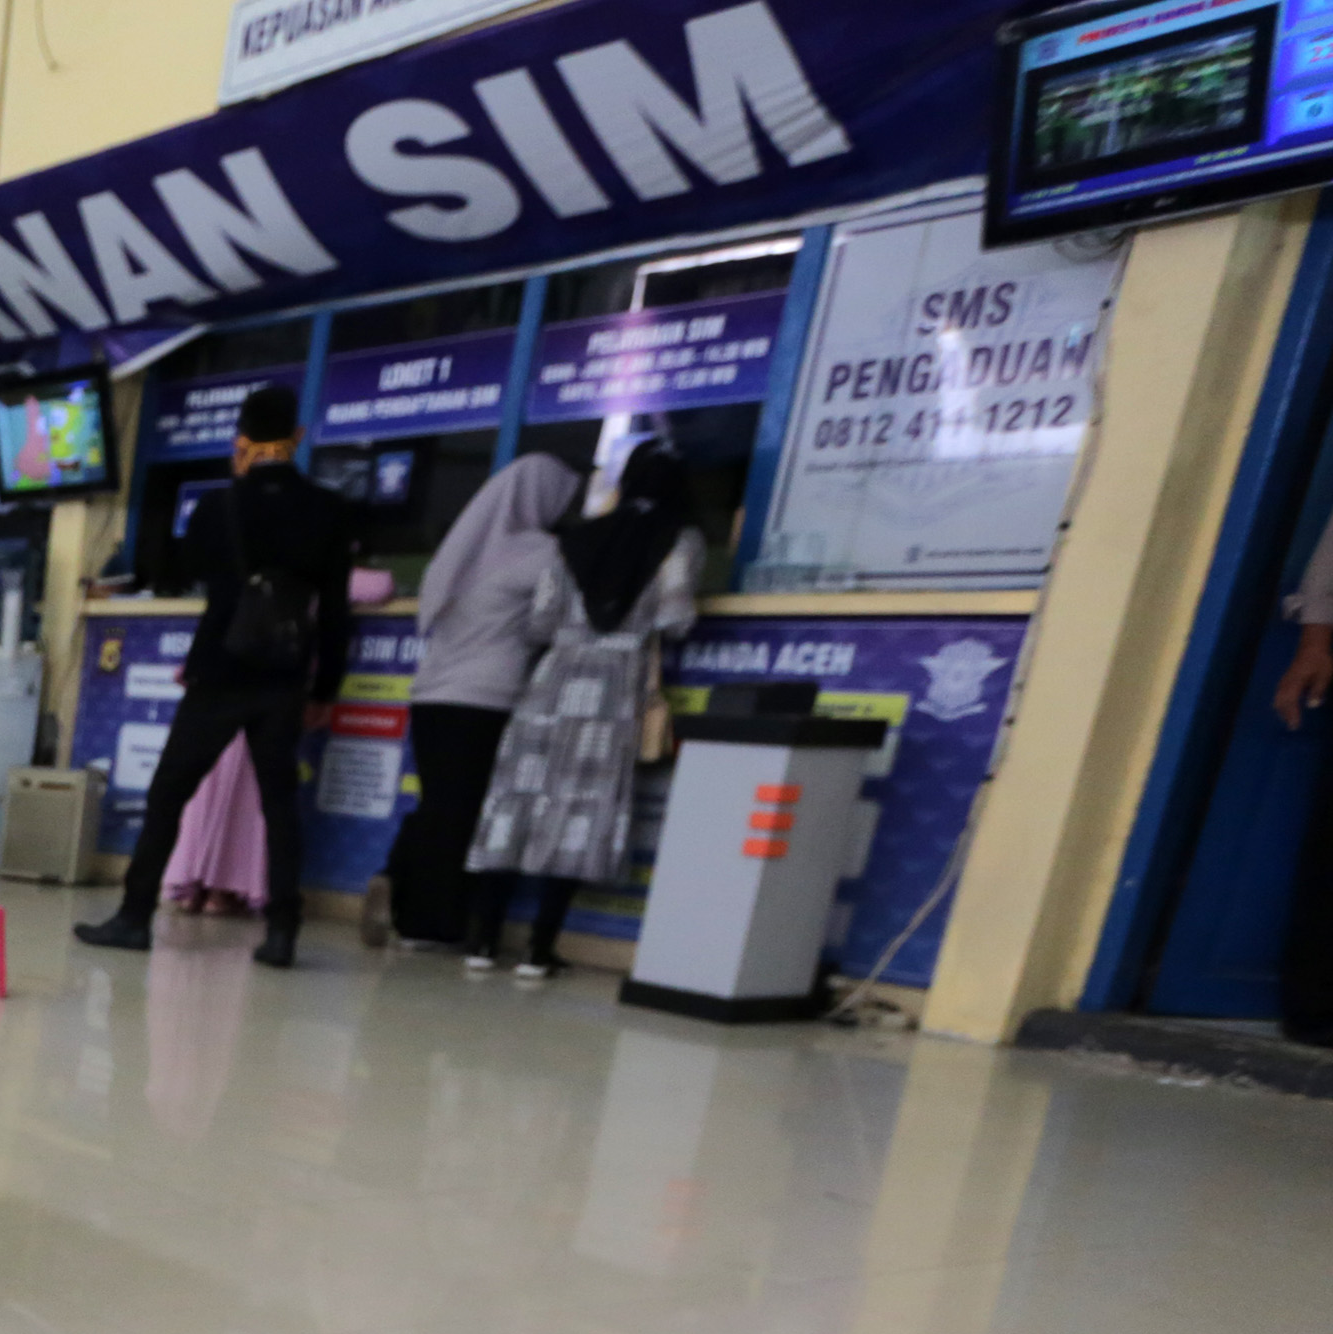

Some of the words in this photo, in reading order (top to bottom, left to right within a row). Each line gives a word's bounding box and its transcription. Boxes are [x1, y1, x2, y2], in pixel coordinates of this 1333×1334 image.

[344, 0, 853, 242] SIM
[917, 282, 1017, 335] SMS
[824, 332, 1094, 404] PENGADUAN
[814, 412, 896, 449] 0812
[984, 395, 1076, 434] 1212
[771, 641, 857, 676] ACEH
